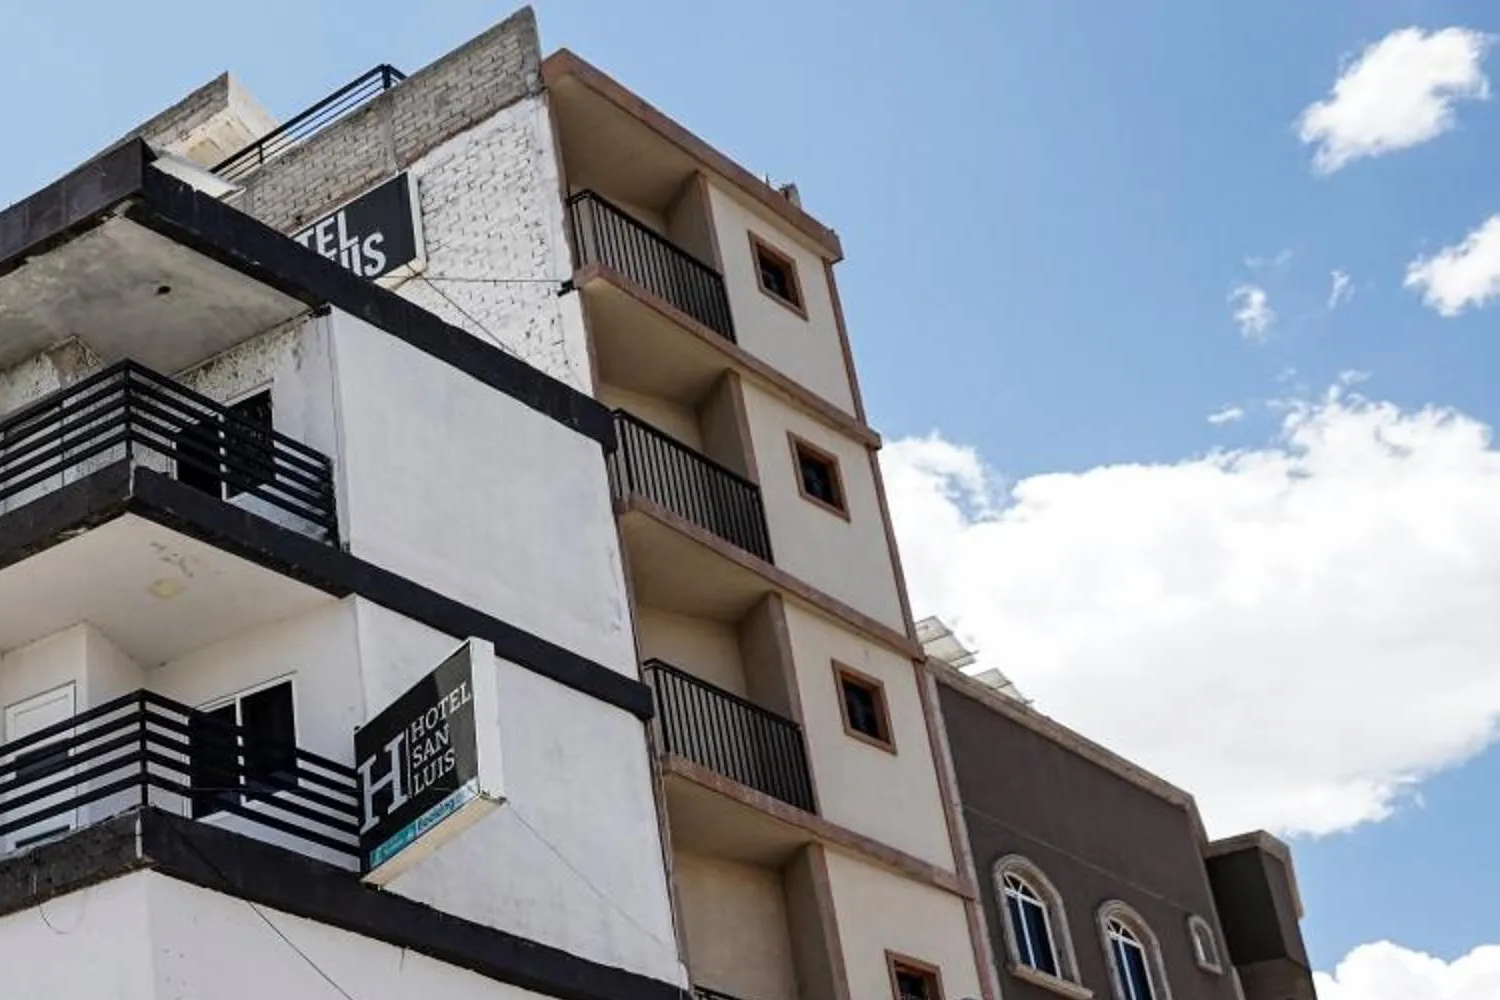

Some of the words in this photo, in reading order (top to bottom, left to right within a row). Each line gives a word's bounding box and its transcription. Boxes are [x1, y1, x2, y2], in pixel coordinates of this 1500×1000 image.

[293, 210, 358, 261] TEL
[411, 682, 472, 744] HOTEL
[412, 724, 451, 768] SAN
[358, 731, 409, 835] H
[413, 749, 456, 796] LUIS
